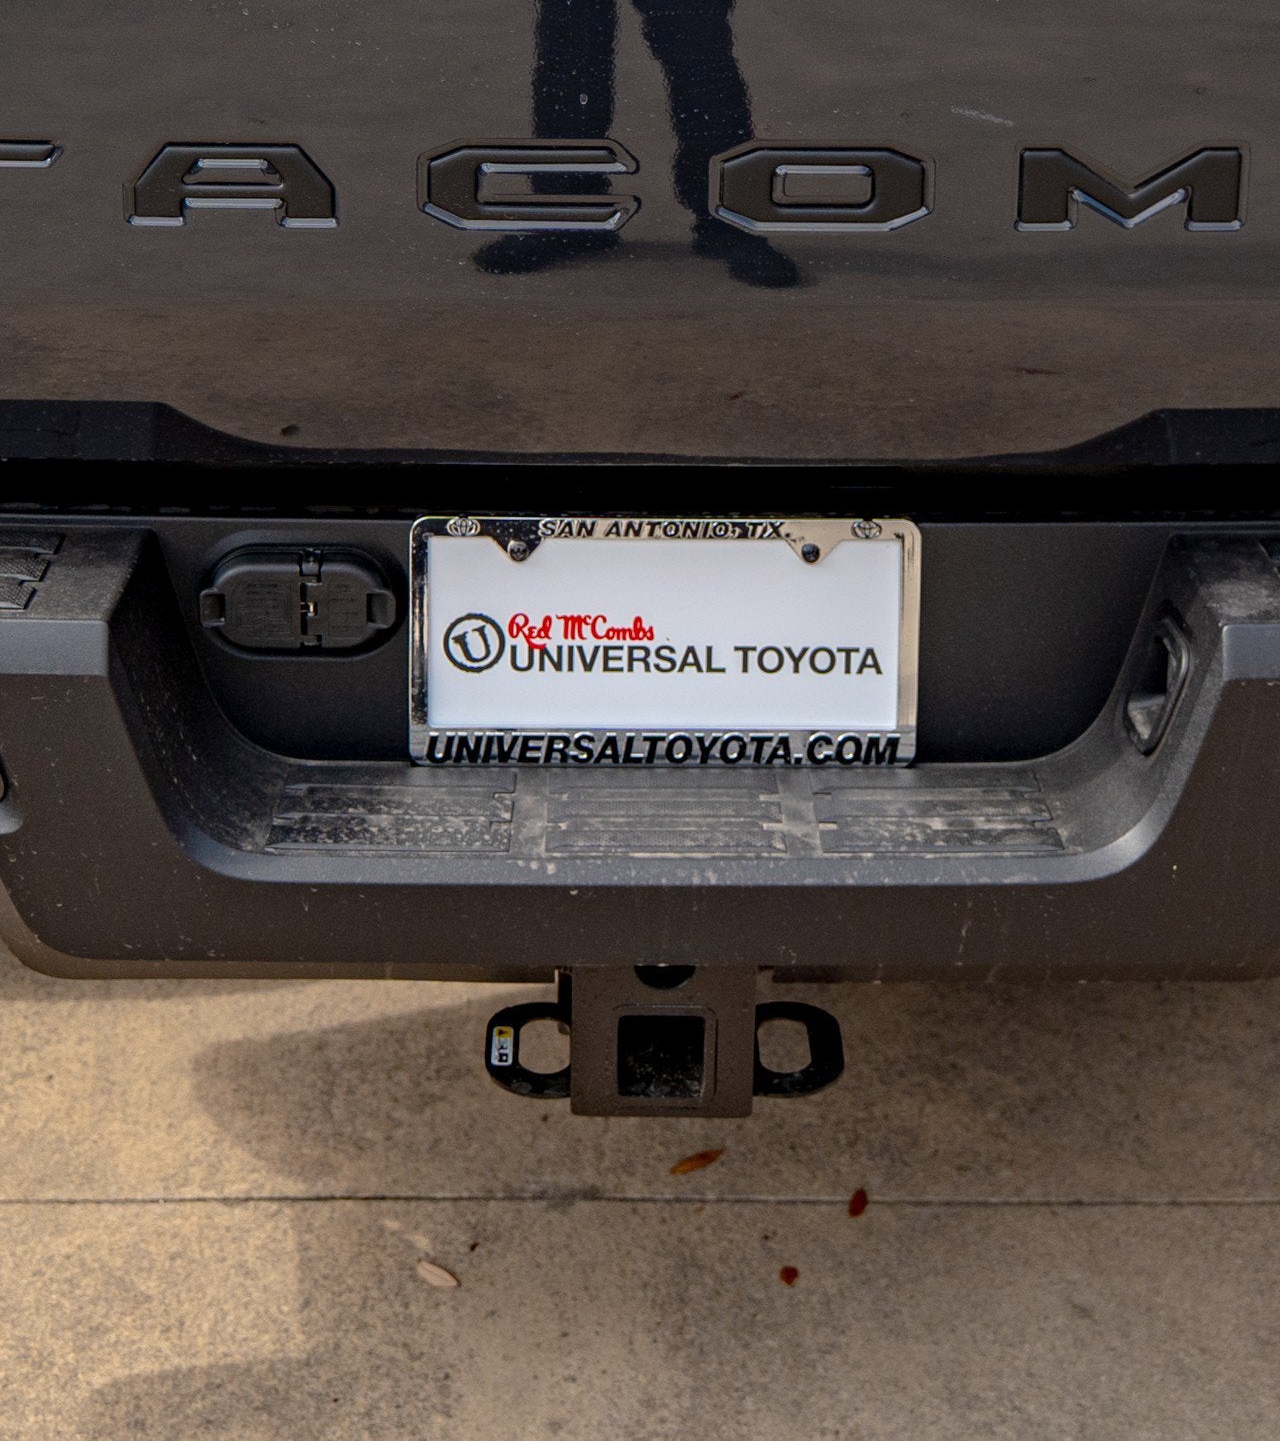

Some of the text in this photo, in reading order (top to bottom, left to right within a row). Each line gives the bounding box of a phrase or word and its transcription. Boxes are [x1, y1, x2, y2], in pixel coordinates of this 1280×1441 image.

[538, 519, 596, 538] SAN
[508, 613, 655, 650] Red McCombs
[510, 644, 883, 674] UNIVERSAL TOYOTA
[425, 731, 901, 764] UNIVERSALTOYOTA.COM
